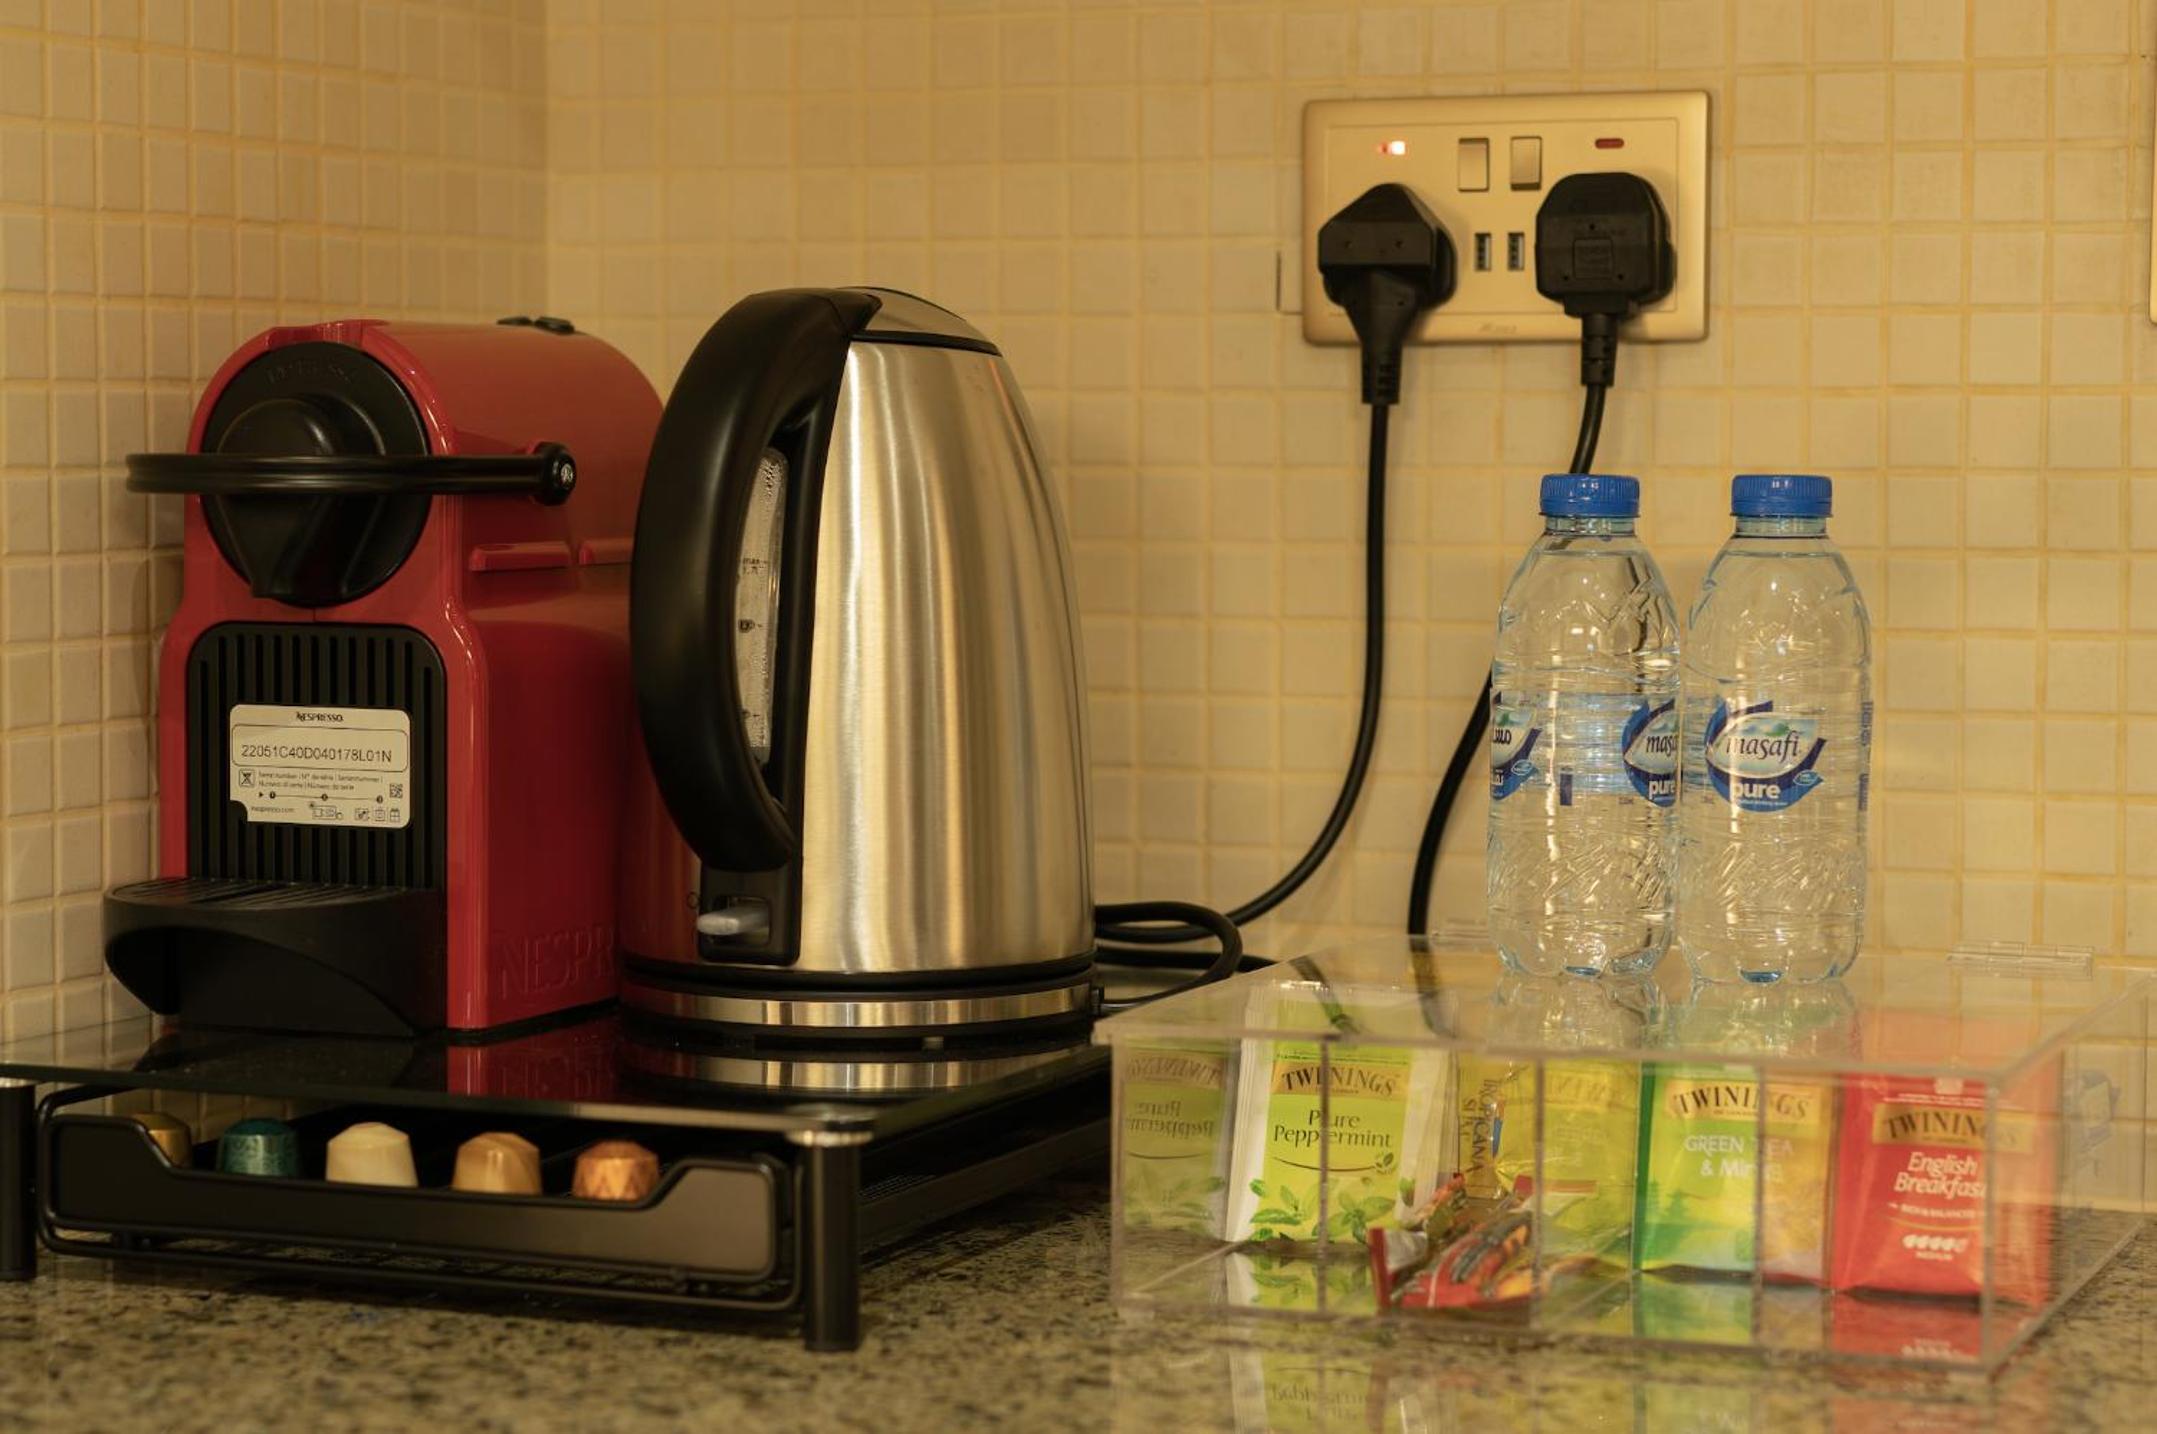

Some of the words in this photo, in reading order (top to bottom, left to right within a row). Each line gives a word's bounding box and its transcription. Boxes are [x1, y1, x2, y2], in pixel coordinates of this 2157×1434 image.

[295, 711, 344, 723] NESPRESSO
[241, 744, 393, 763] 22051C40D040178L01N
[500, 925, 615, 1001] NESPR
[1281, 1066, 1396, 1098] TWININGS
[1274, 1124, 1393, 1149] Peppermint
[1887, 1110, 2018, 1144] TWININS
[1684, 1135, 1745, 1157] GREEN
[1701, 1159, 1713, 1177] &
[1908, 1151, 1979, 1177] English
